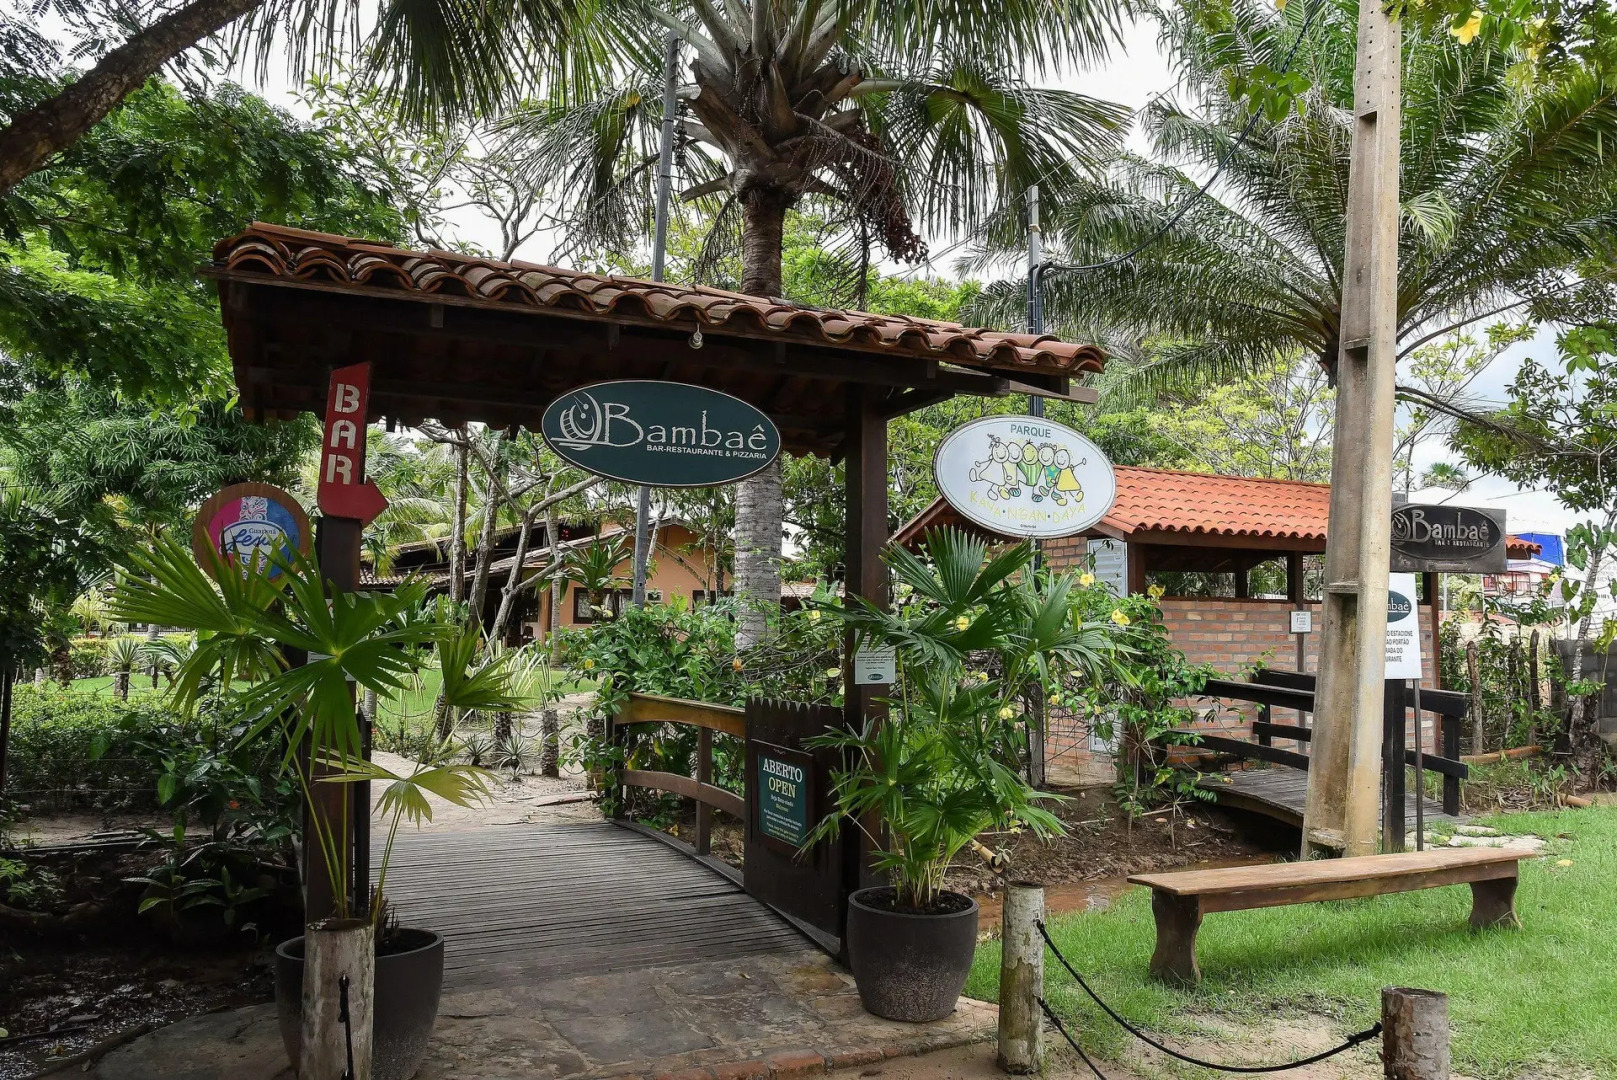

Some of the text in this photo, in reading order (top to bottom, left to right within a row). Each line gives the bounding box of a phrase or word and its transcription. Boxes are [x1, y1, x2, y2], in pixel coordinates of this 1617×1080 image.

[325, 383, 361, 486] BAR
[603, 402, 767, 450] Bambaê
[1010, 423, 1052, 439] PARQUE
[646, 444, 768, 460] BAR-RESTAURANTE & PIZZARIA
[1052, 502, 1086, 524] DAYA
[1411, 509, 1490, 543] Bambaê
[1393, 636, 1410, 646] PORTÃO
[763, 758, 803, 783] ABERTO
[768, 776, 797, 799] OPEN
